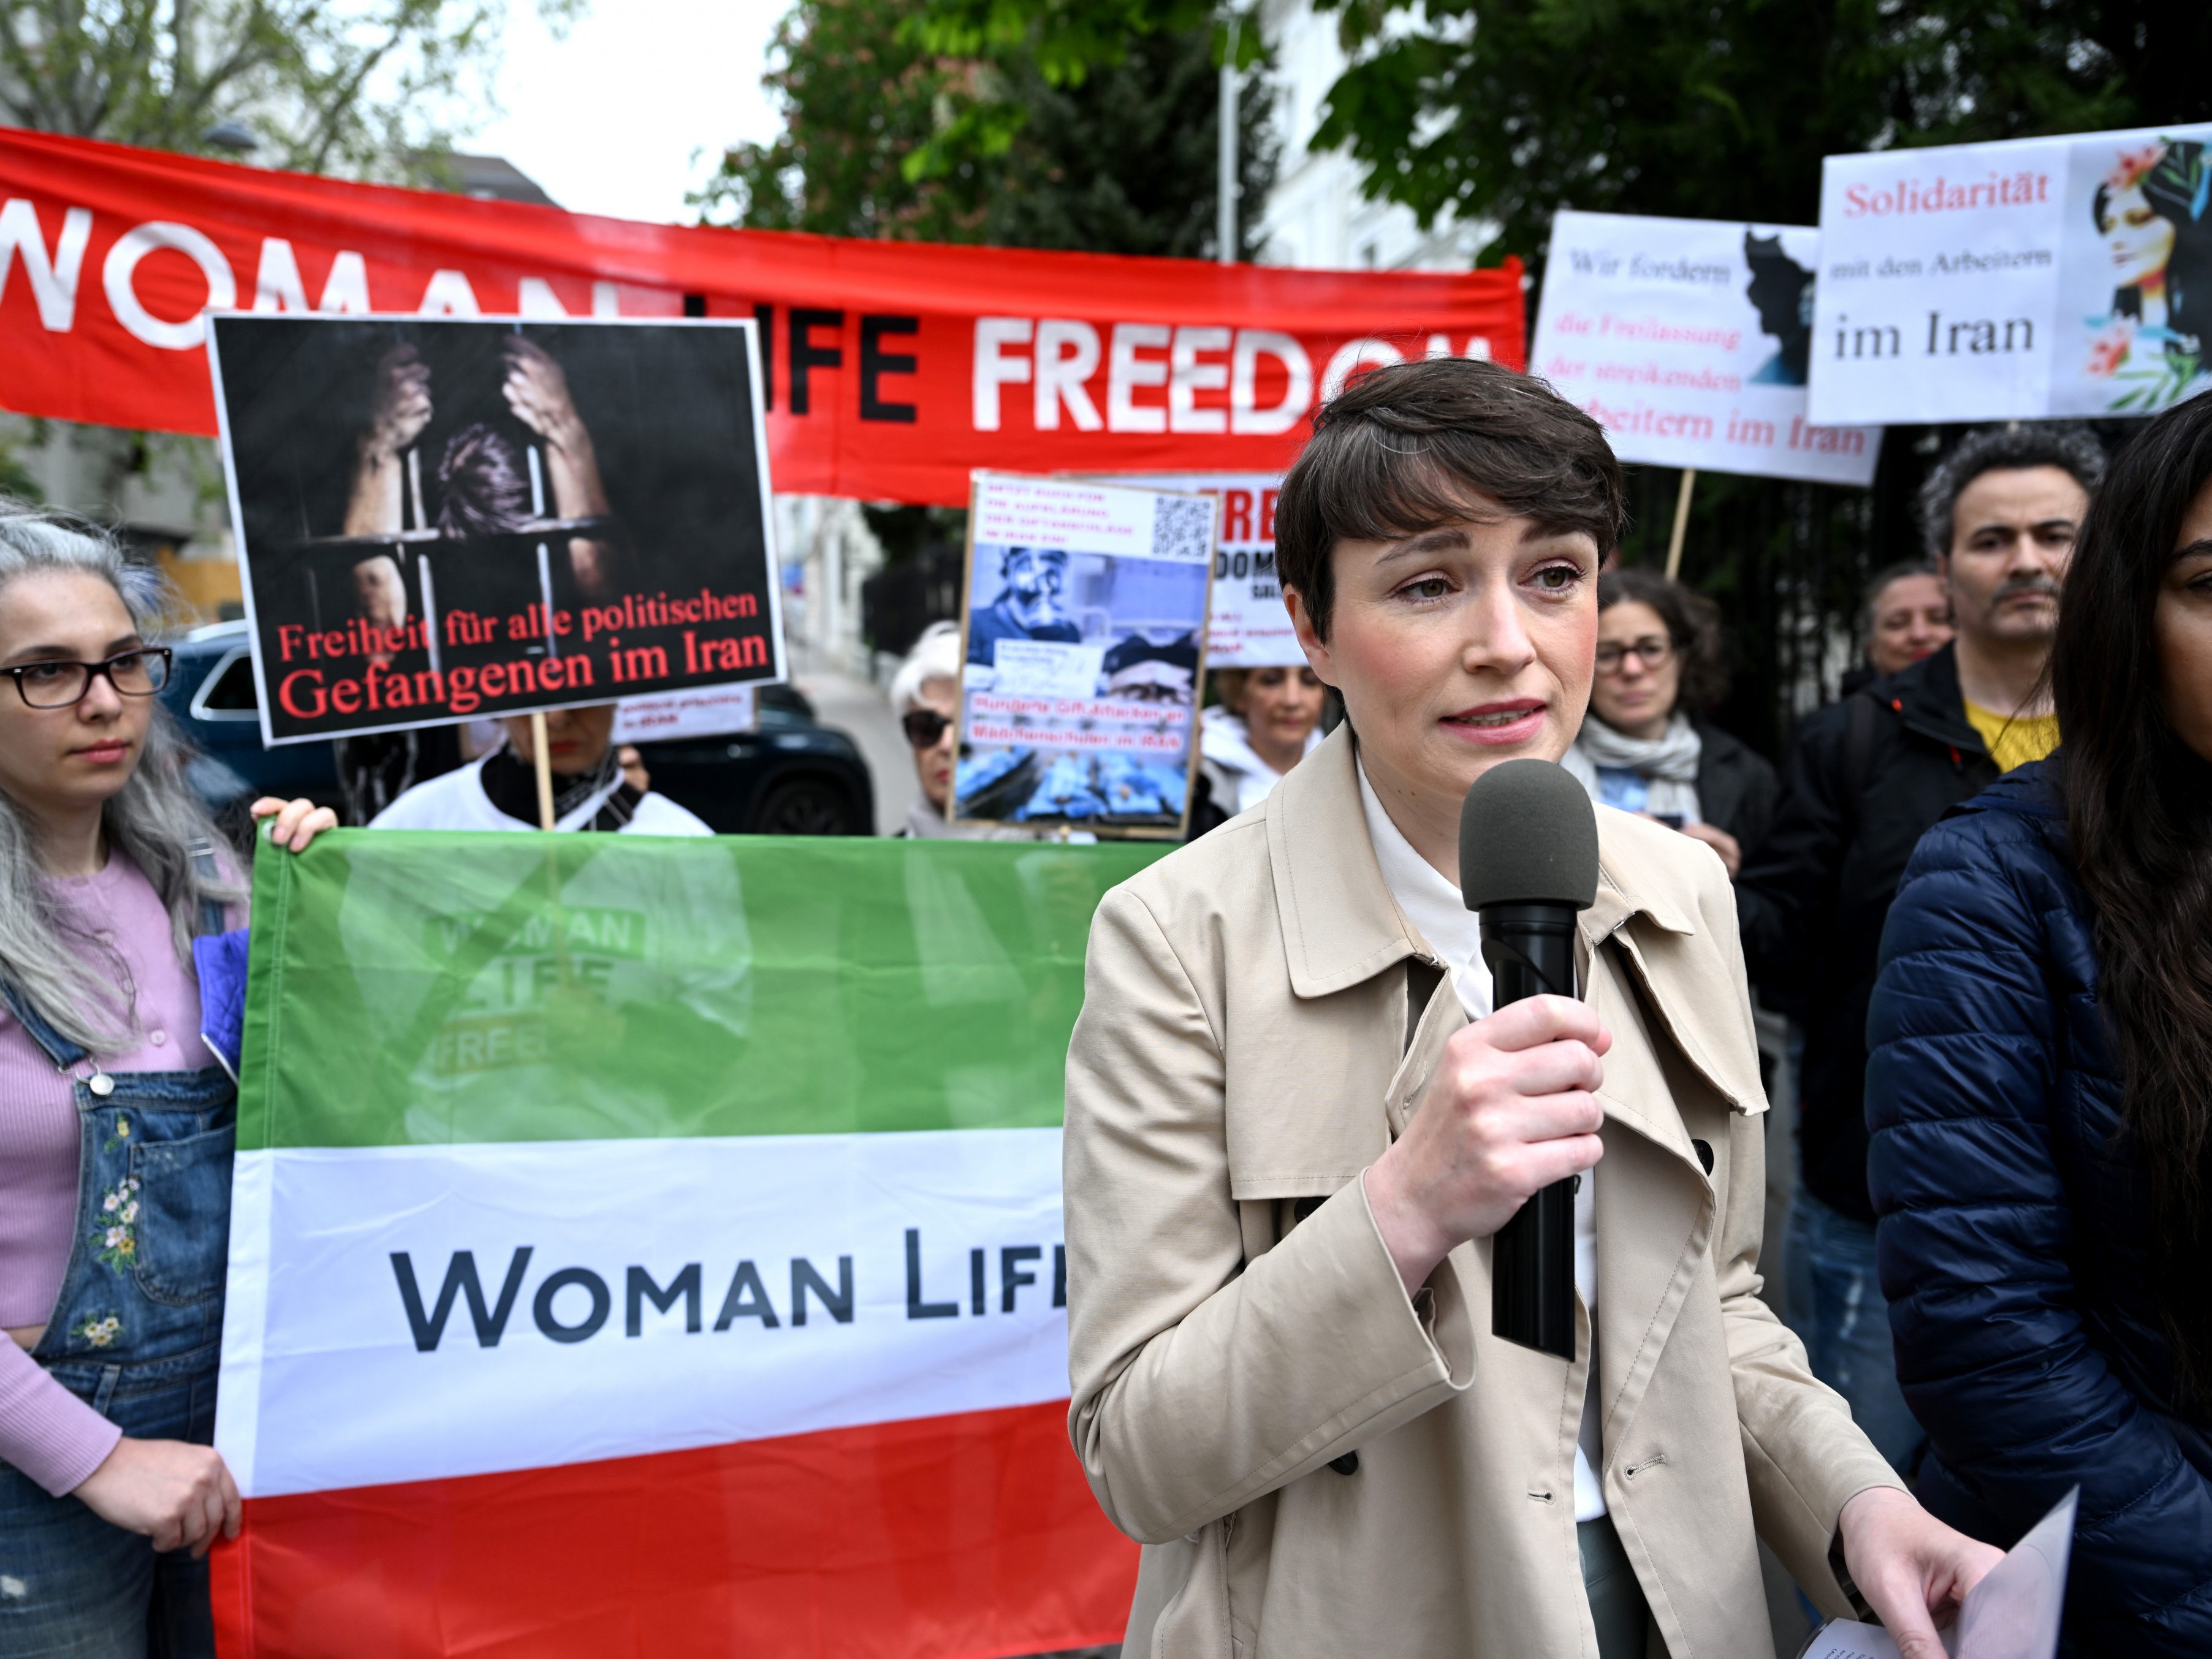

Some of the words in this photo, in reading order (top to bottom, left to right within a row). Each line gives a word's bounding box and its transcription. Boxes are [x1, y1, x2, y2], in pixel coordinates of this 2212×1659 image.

[1844, 172, 2049, 218] Solidarität
[1571, 249, 1620, 277] Wir
[1629, 252, 1731, 284] fordern
[1830, 257, 1870, 278] mit
[1877, 254, 1923, 277] den
[1930, 248, 2052, 275] Arbeitern
[1555, 313, 1592, 334] die
[1598, 313, 1741, 351] Freilassung
[1835, 313, 1901, 359] im
[1927, 311, 2034, 355] Iran
[682, 293, 918, 424] IFE
[1595, 359, 1743, 392] streikenden
[1727, 407, 1775, 447] im
[1787, 413, 1865, 457] Iran
[277, 615, 433, 662] Freiheit
[445, 609, 498, 647] für
[508, 602, 572, 640] alle
[580, 588, 758, 642] politischen
[279, 653, 595, 719] Gefangenen
[609, 637, 669, 684] im
[682, 630, 768, 674] Iran
[389, 1246, 854, 1352] WOMAN
